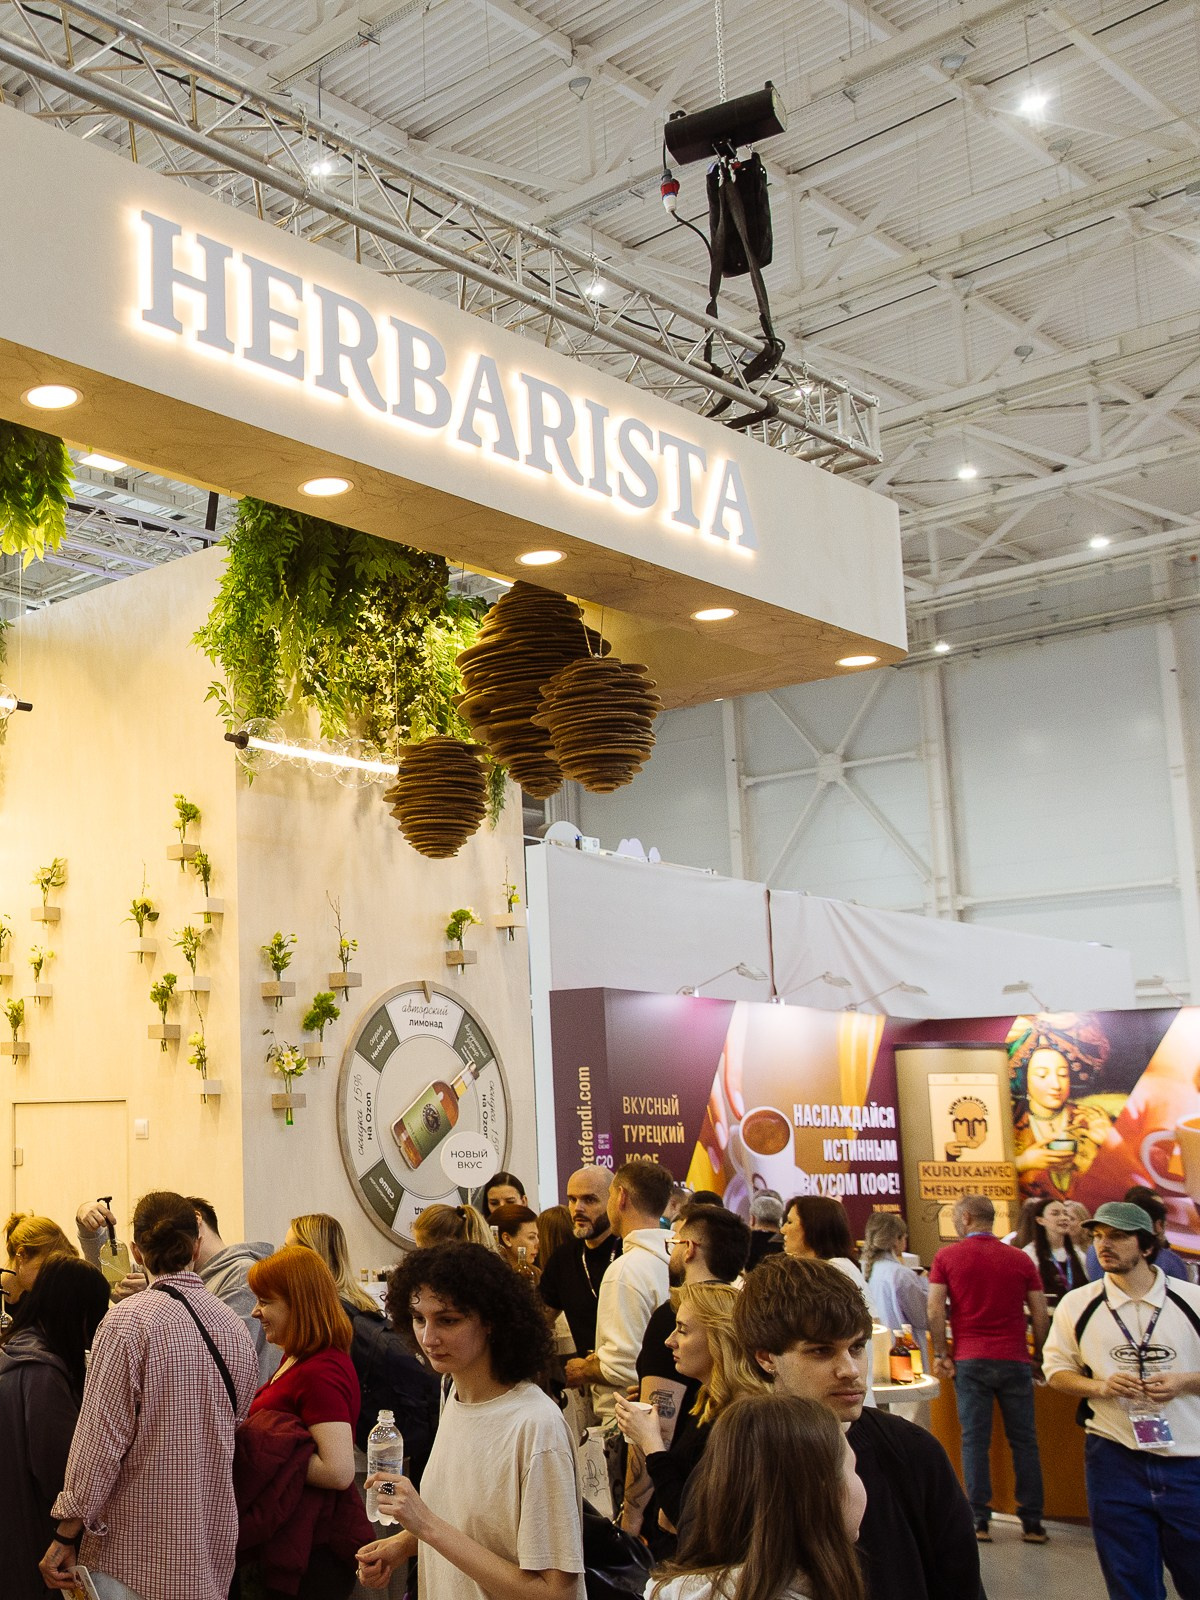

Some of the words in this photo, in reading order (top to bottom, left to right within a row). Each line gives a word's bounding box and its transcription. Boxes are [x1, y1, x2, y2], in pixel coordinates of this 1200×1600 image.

[140, 208, 760, 552] HERBARISTA
[409, 1019, 443, 1030] лимонад
[577, 1066, 595, 1168] tefendi.com
[622, 1094, 680, 1116] ВКУСНЫЙ
[793, 1101, 896, 1132] НАСЛАЖДАЙСЯ
[622, 1121, 685, 1146] ТУРЕЦКИЙ
[450, 1148, 488, 1158] НОВЫЙ
[822, 1138, 898, 1162] ИСТИННЫМ
[457, 1161, 483, 1169] ВКУС
[802, 1172, 858, 1197] ВКУСОМ
[860, 1172, 901, 1196] КОФЕ!
